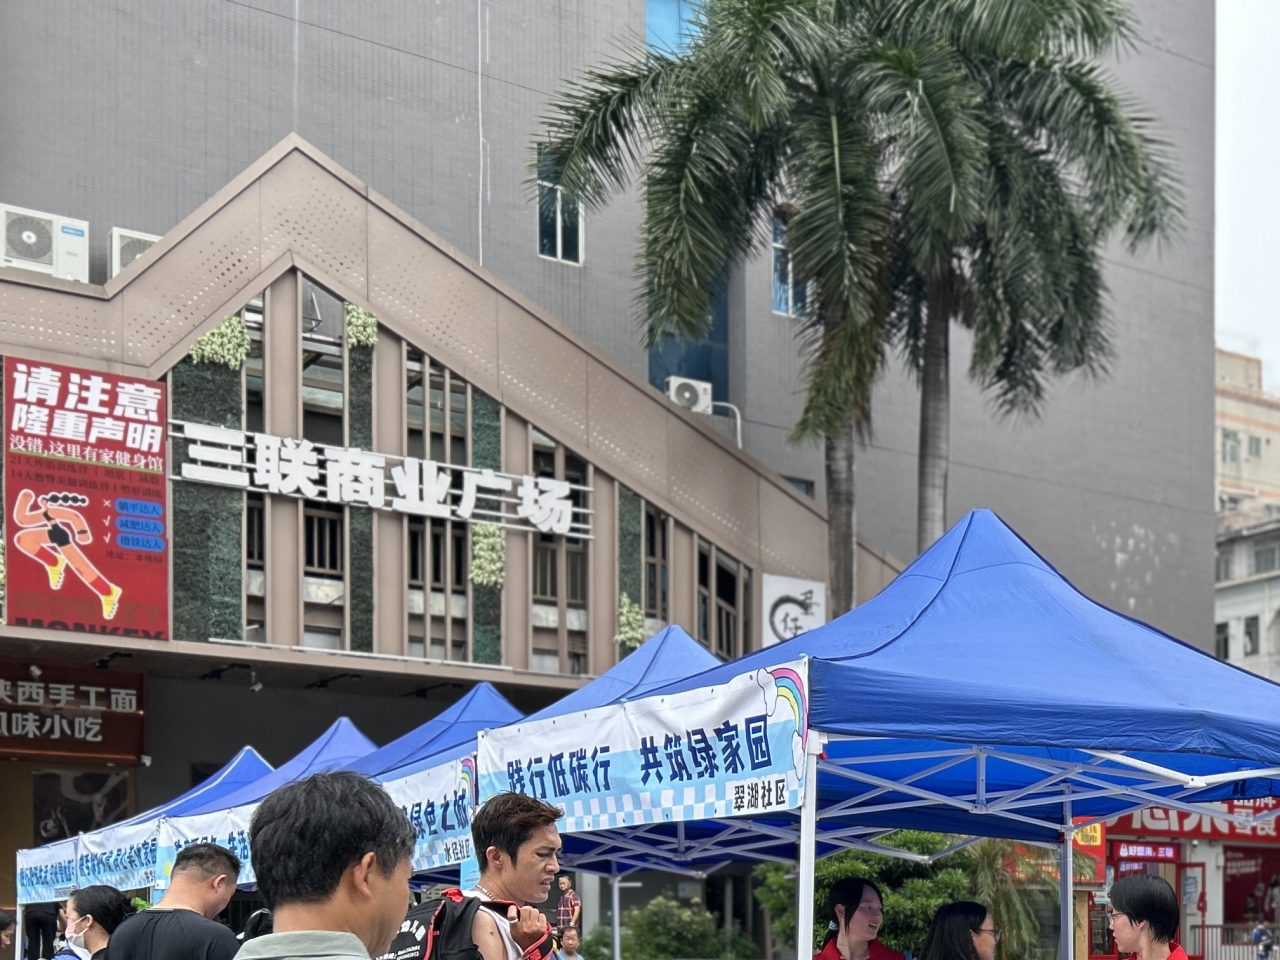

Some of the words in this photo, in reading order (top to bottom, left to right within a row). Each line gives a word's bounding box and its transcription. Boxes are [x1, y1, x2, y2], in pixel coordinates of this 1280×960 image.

[13, 363, 161, 422] 请注意
[11, 402, 163, 453] 隆重声明
[181, 421, 573, 534] 三联商业广场
[507, 745, 611, 800] 践行低碳行
[639, 714, 773, 786] 共筑绿家园
[402, 785, 468, 839] 绿色之城
[733, 778, 787, 812] 翠湖社区
